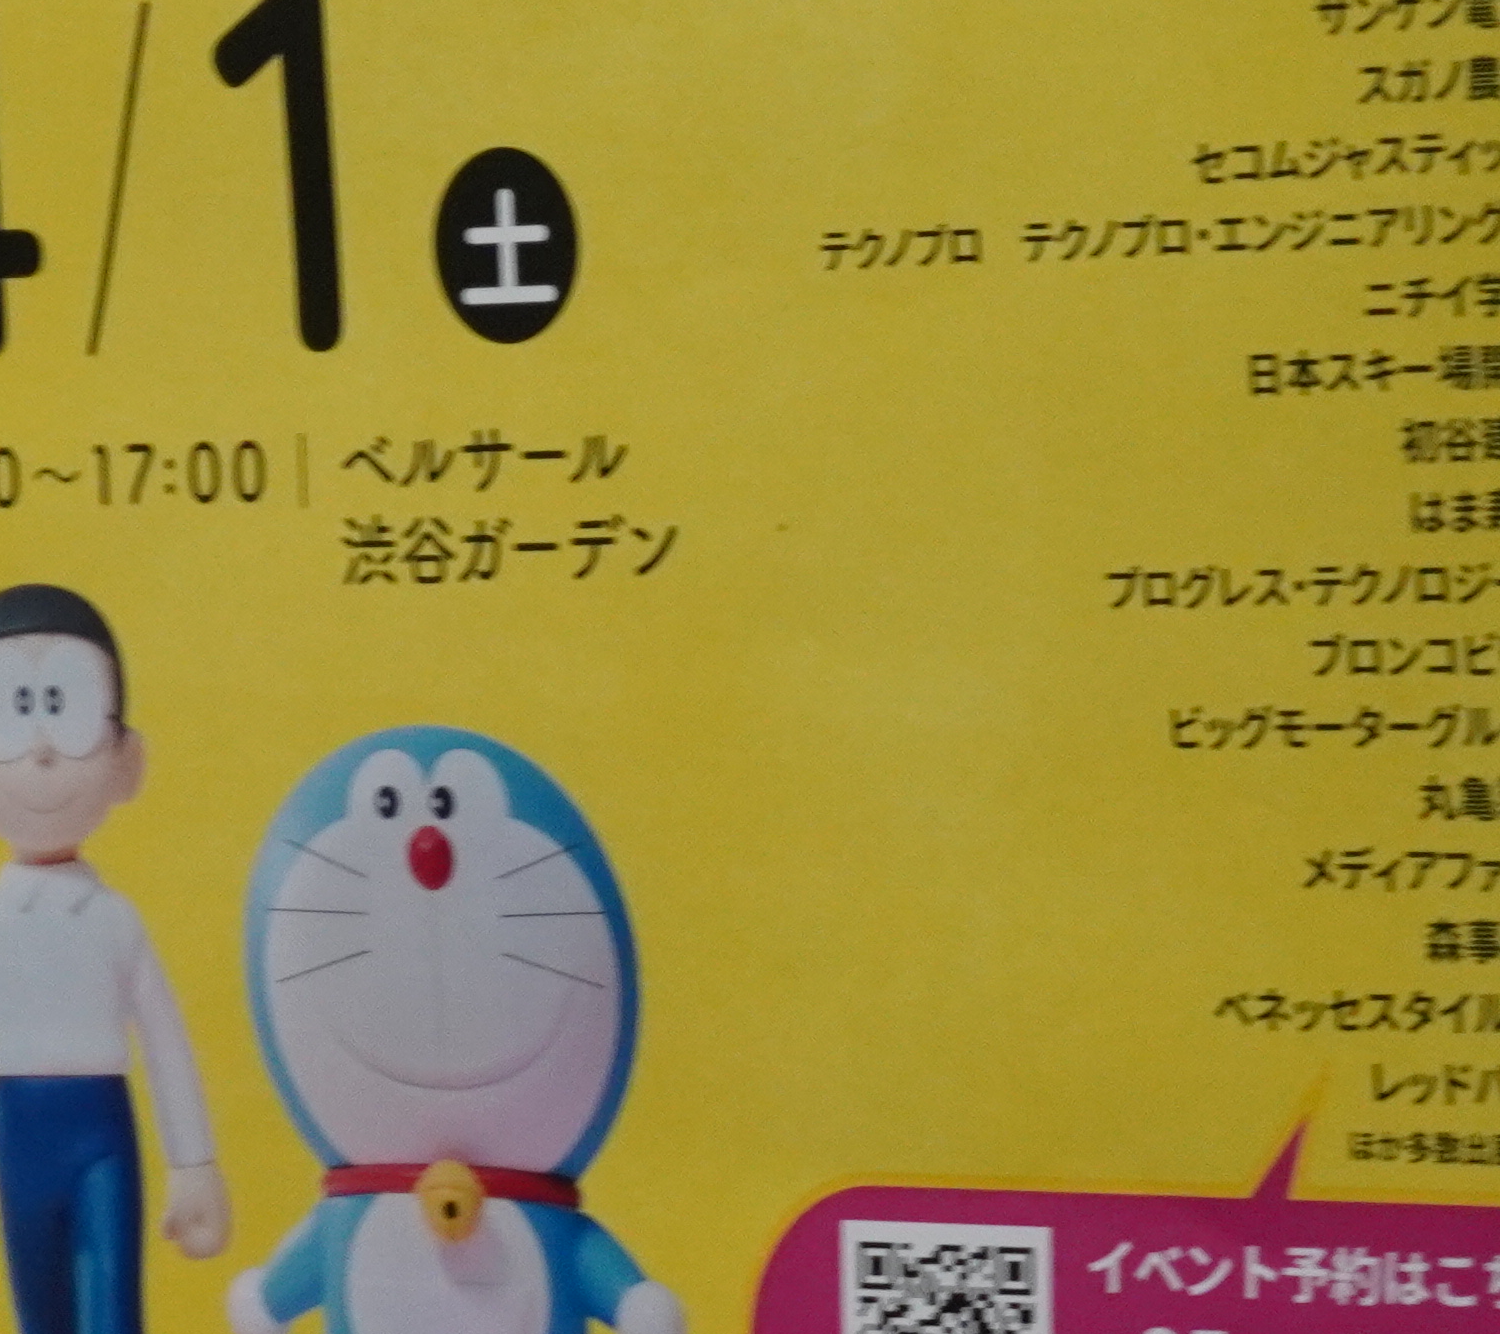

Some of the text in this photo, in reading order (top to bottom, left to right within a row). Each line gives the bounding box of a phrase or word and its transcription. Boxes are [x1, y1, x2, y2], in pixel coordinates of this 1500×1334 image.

[461, 185, 559, 307] 土
[820, 225, 981, 270] テクノプロ
[342, 429, 628, 493] ベルサール
[342, 514, 680, 586] 渋谷ガーデン
